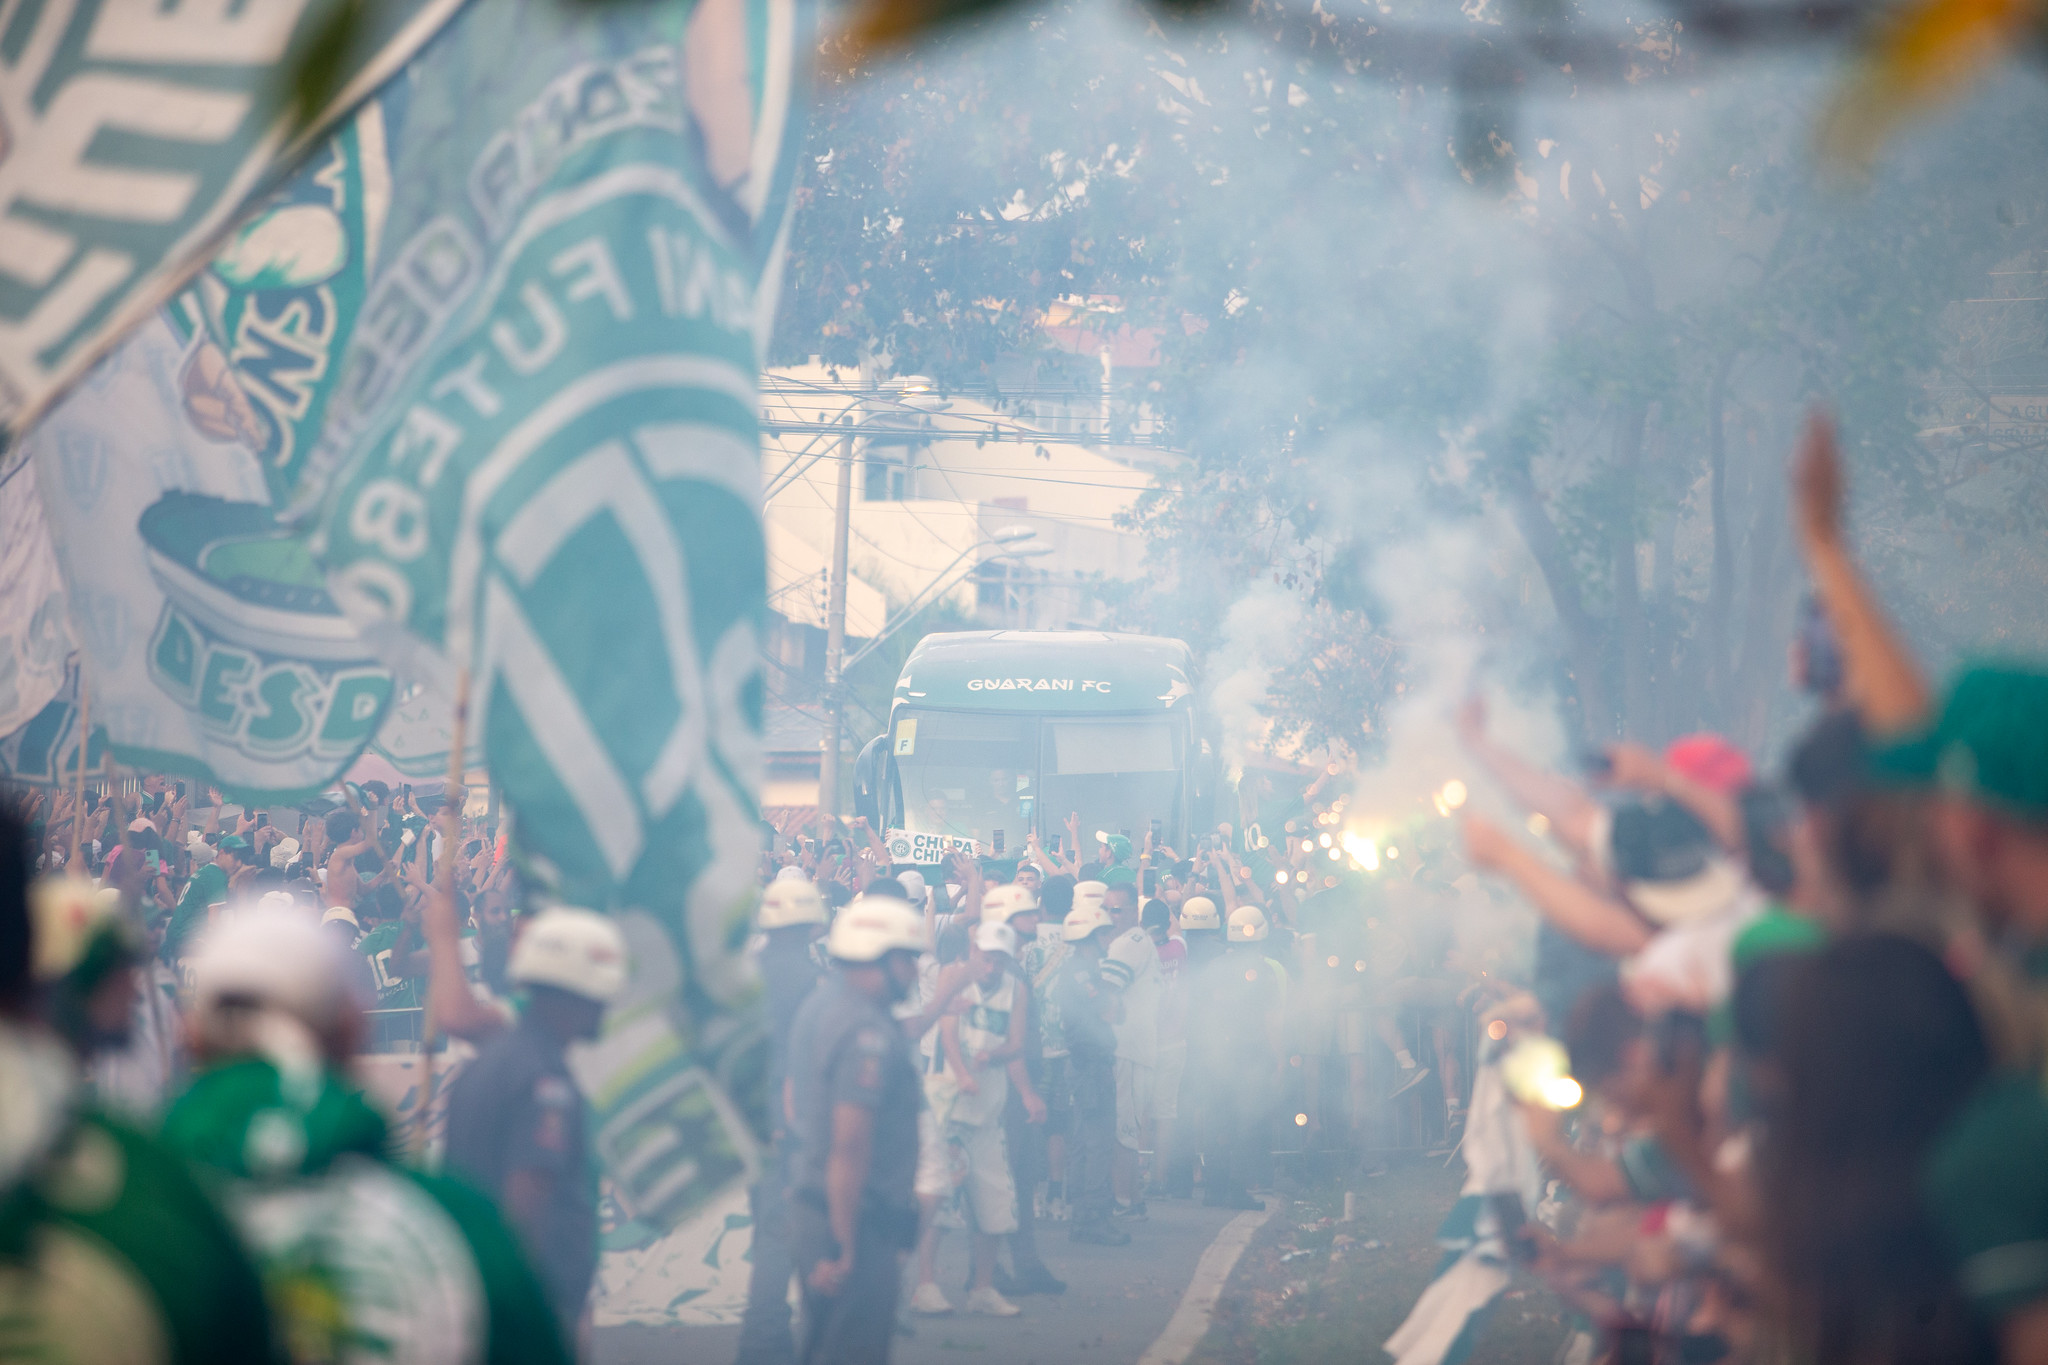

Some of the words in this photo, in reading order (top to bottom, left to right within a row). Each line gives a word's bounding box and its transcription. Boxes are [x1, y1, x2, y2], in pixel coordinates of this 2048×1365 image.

[967, 678, 1074, 692] GUARANI
[1081, 680, 1112, 693] FC
[912, 847, 944, 863] CHI
